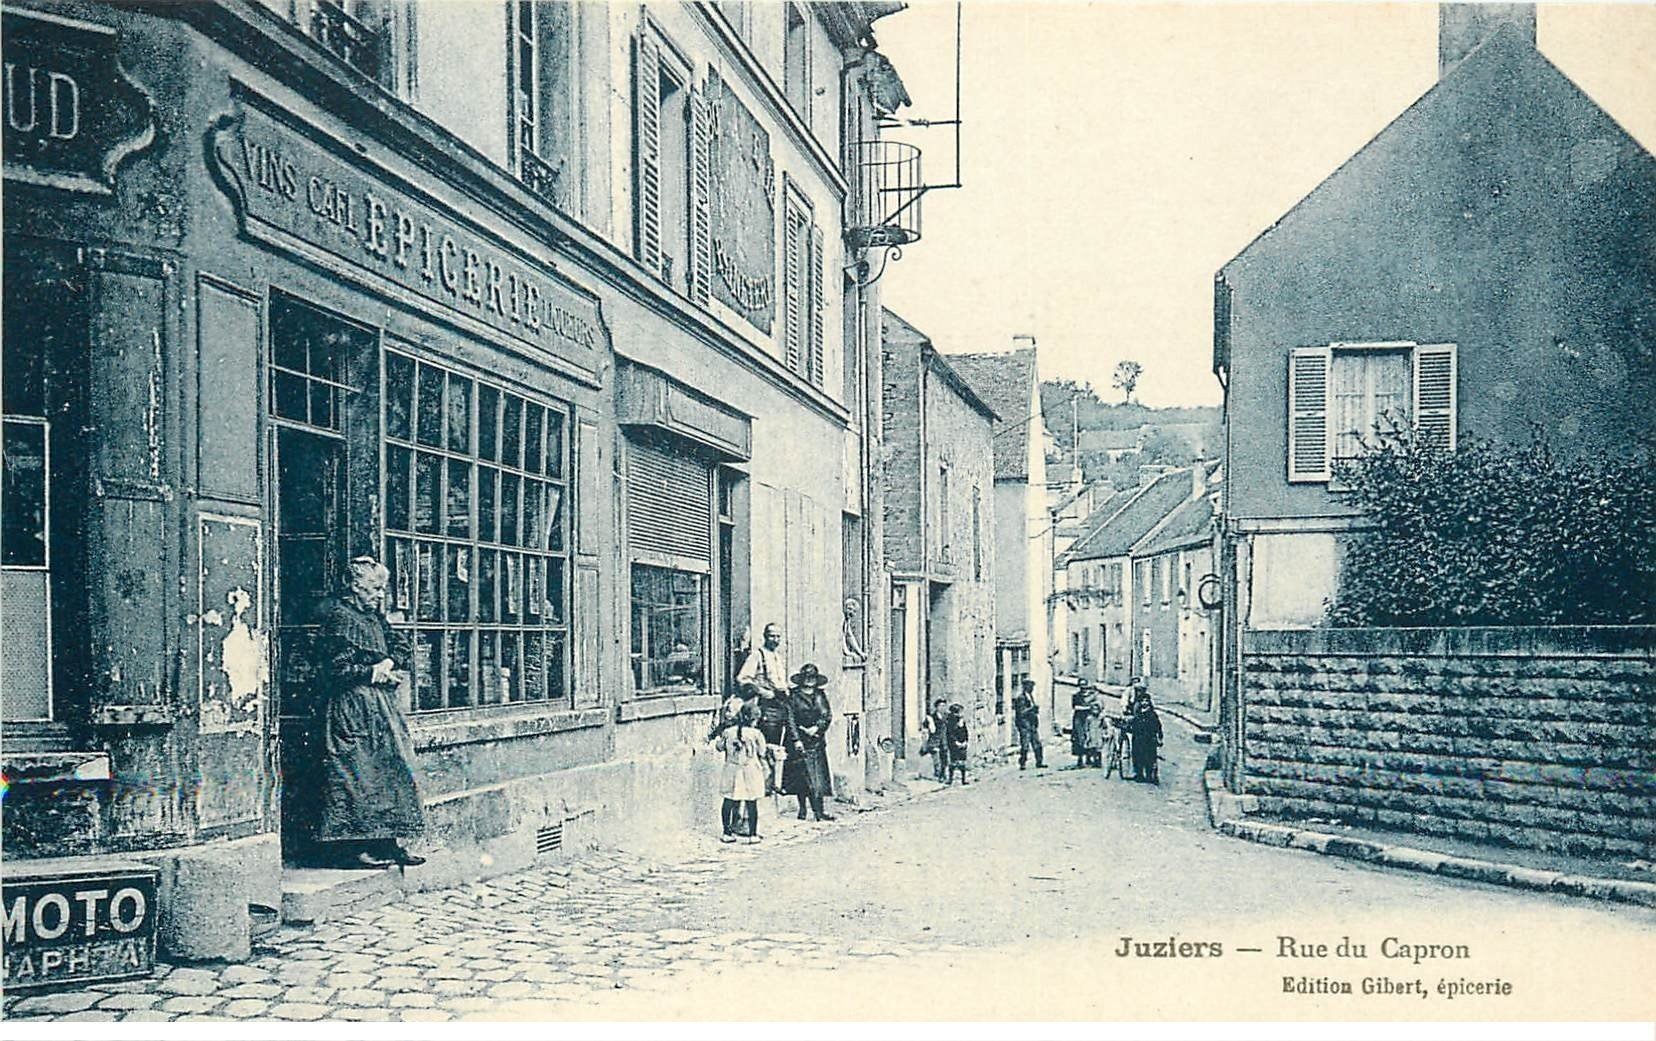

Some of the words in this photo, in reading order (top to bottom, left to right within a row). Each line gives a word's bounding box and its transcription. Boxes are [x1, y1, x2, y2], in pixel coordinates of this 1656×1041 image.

[242, 137, 297, 202] VINS
[363, 192, 541, 336] EPICERIE
[2, 887, 146, 943] MOTO
